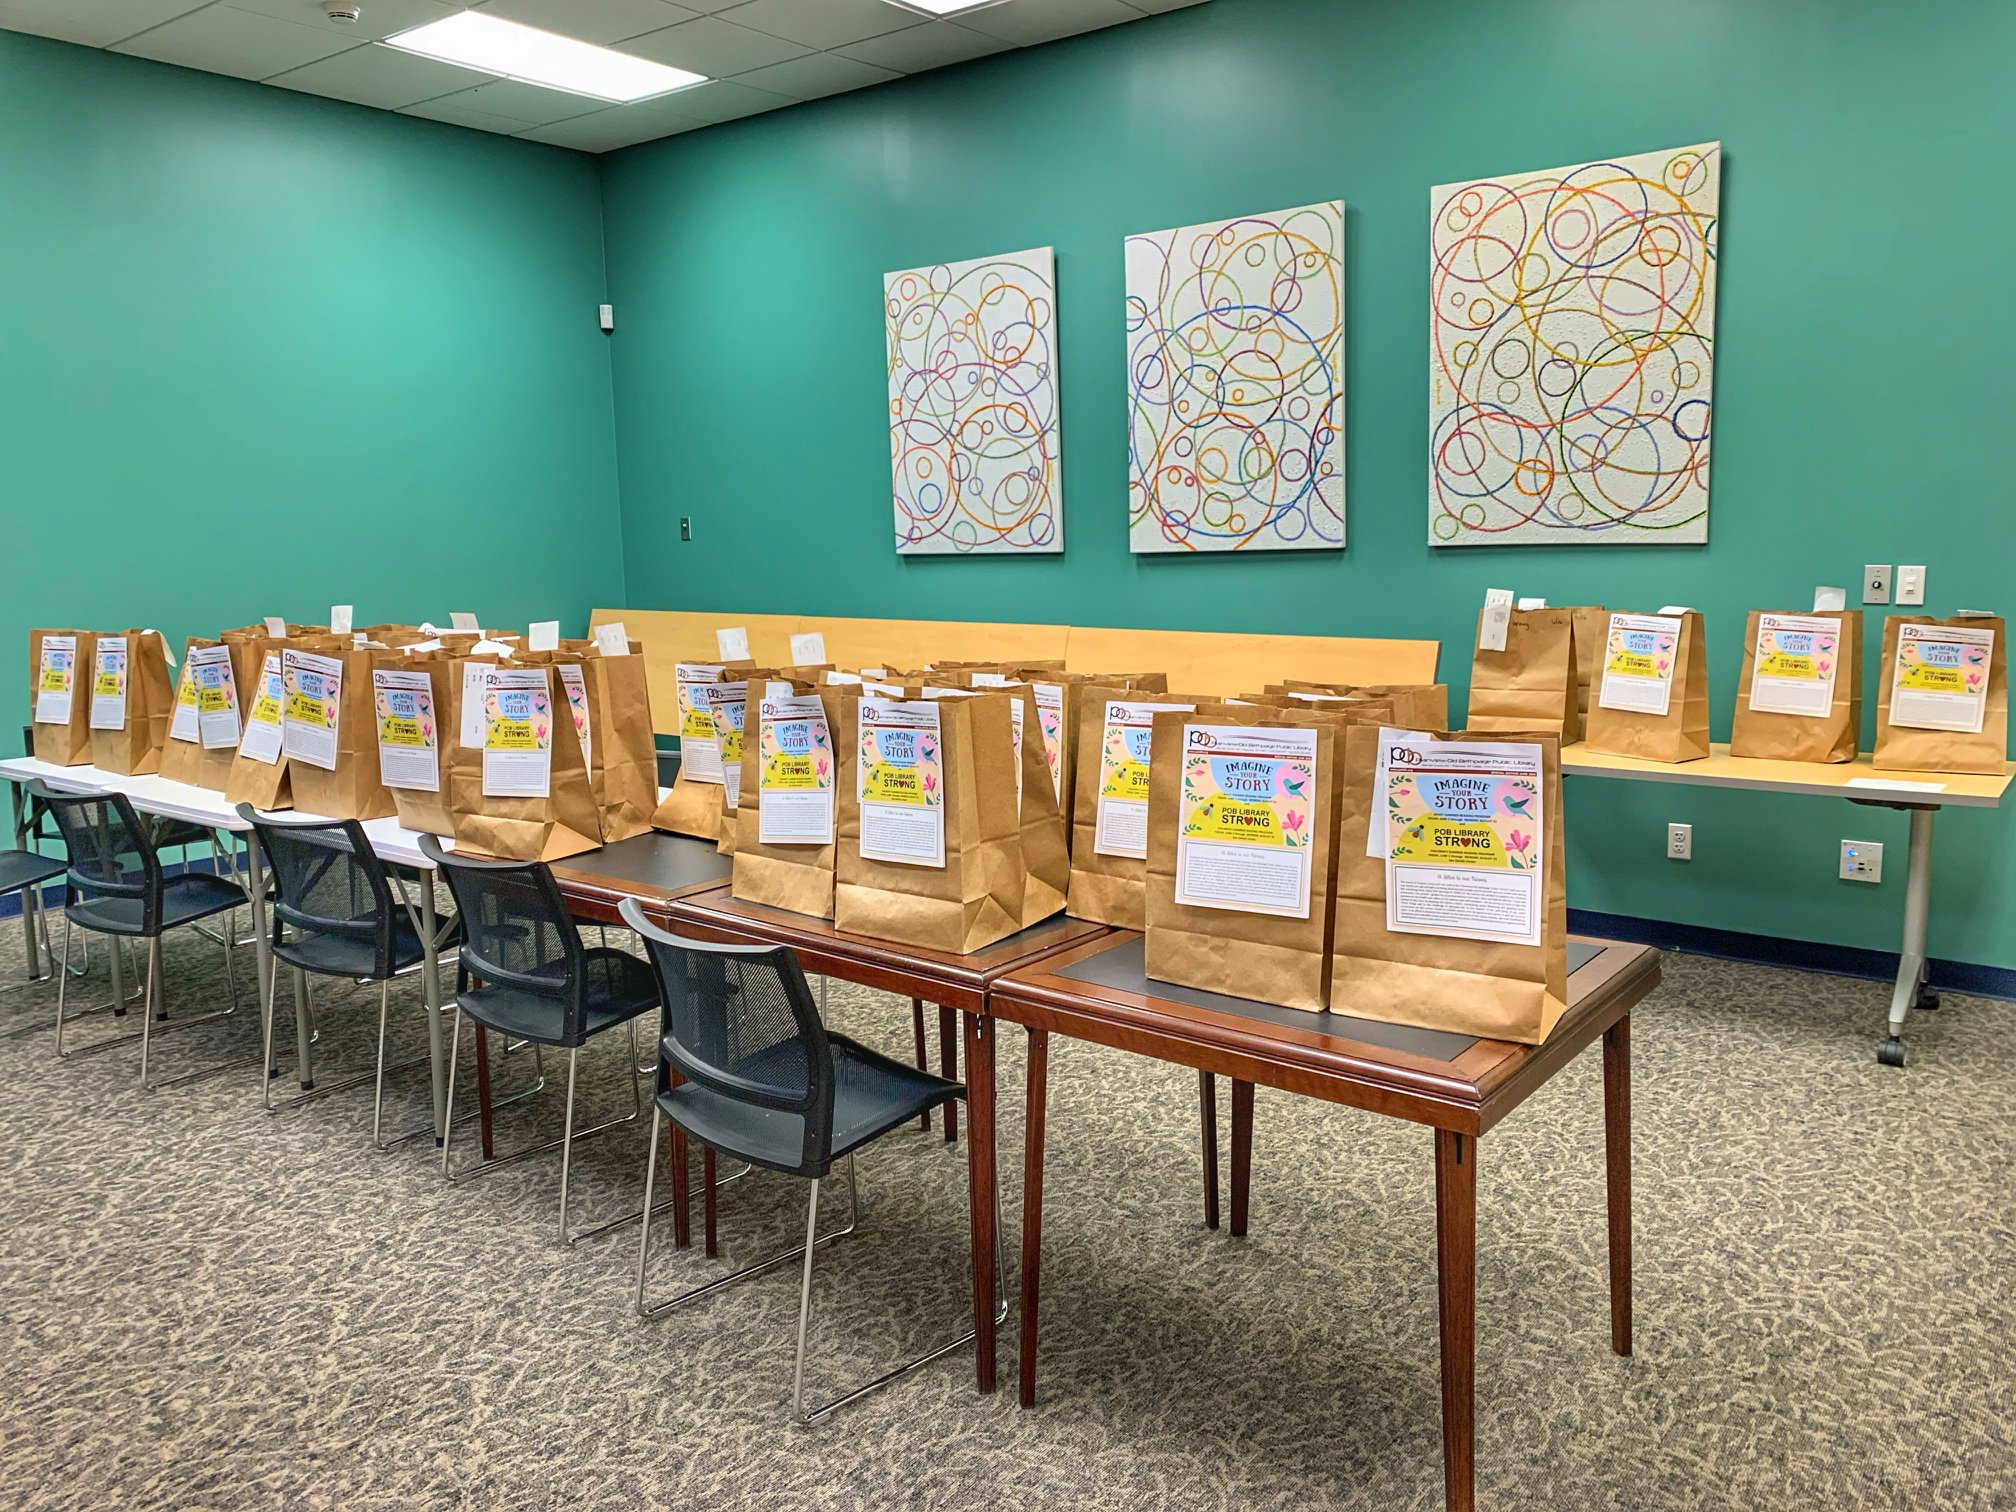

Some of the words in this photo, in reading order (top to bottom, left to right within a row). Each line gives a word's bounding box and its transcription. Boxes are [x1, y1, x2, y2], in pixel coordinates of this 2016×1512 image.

[1629, 641, 1653, 650] STORY
[1784, 642, 1810, 651] STORY
[1927, 653, 1959, 662] STORY
[505, 692, 529, 702] IMAGINE
[393, 703, 415, 712] STORY
[505, 704, 529, 713] STORY
[783, 724, 808, 734] IMAGINE
[783, 736, 809, 748] STORY
[885, 732, 915, 744] IMAGINE
[885, 746, 915, 758] STORY
[1459, 758, 1491, 766] Bethpage
[1225, 761, 1274, 775] IMAGINE
[1225, 776, 1271, 791] STORY
[1434, 778, 1490, 794] IMAGINE
[1451, 789, 1472, 797] YOUR
[1435, 795, 1488, 811] STORY
[1222, 807, 1238, 815] POB
[1239, 808, 1271, 817] LIBRARY
[1434, 828, 1452, 836] POB
[1454, 829, 1491, 838] LIBRARY
